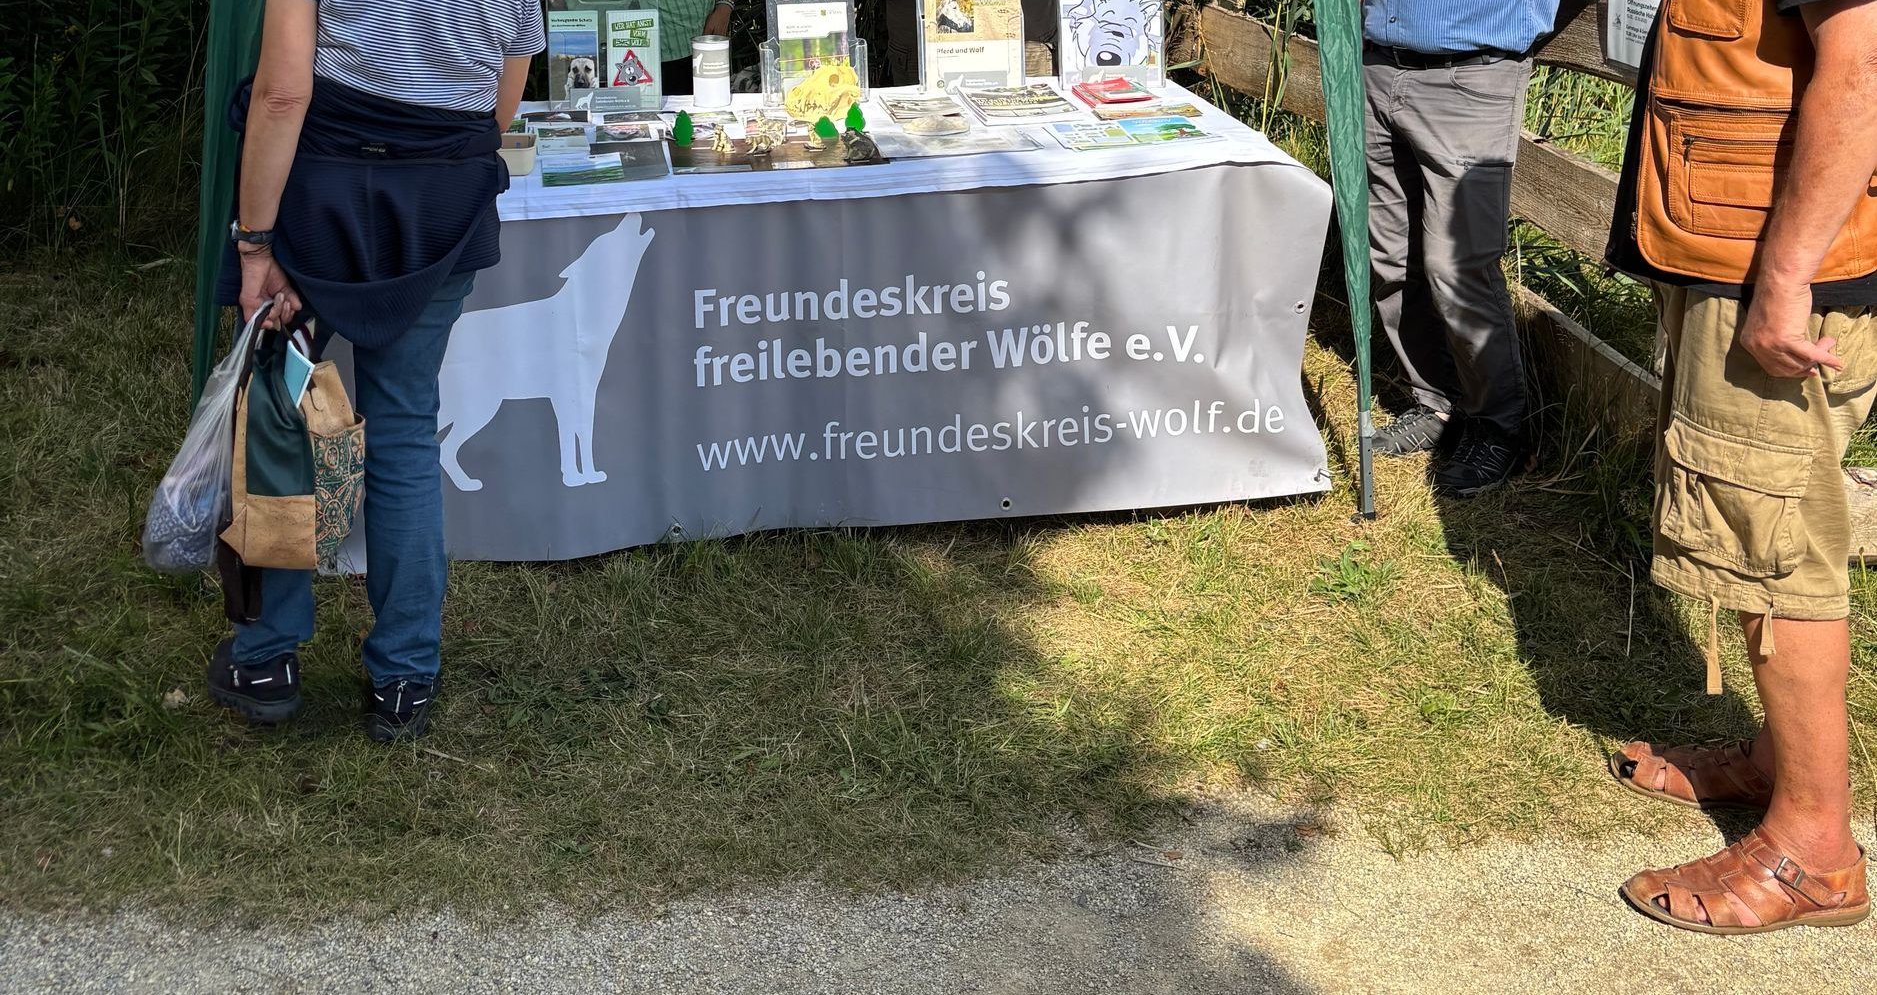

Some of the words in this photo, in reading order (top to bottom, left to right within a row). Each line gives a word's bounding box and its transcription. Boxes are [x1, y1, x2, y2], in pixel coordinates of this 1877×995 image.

[969, 46, 985, 54] Wolf
[694, 270, 1010, 328] Freundeskreis
[694, 331, 977, 387] freilebender
[986, 321, 1111, 369] Wölfe
[1125, 325, 1205, 363] e.V.
[696, 398, 1285, 471] www.freundeskreis-wolf.de
